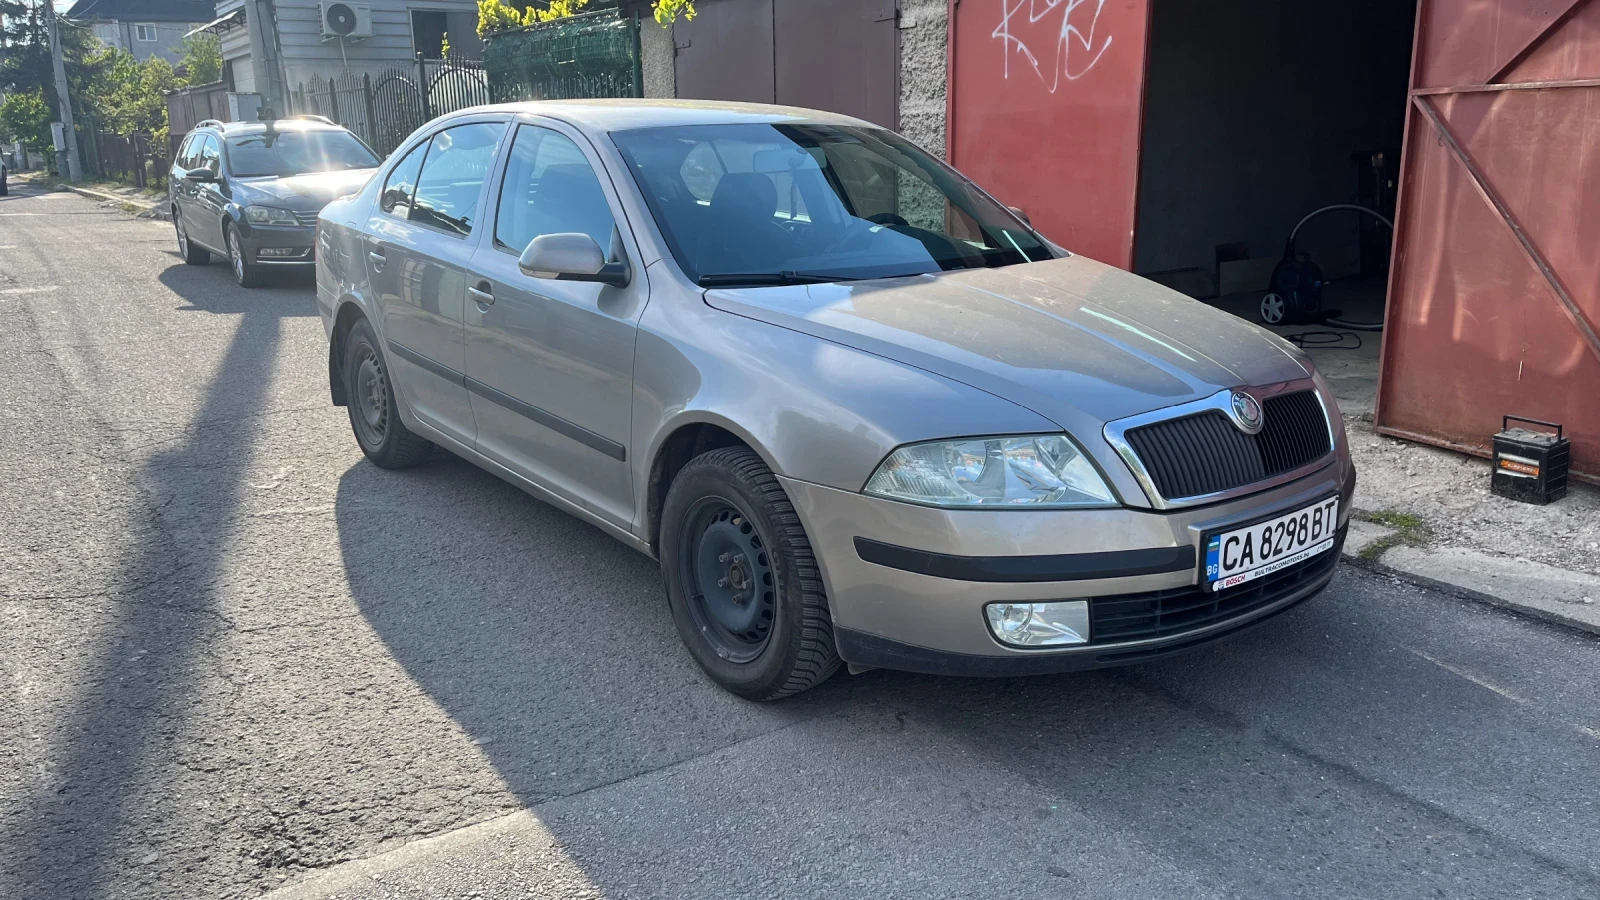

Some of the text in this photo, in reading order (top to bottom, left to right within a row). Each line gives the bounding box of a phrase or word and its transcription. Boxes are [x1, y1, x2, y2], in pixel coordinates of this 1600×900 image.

[1222, 501, 1336, 571] CA 8298 BT
[1206, 564, 1218, 576] BG
[1225, 574, 1246, 587] BOSCH
